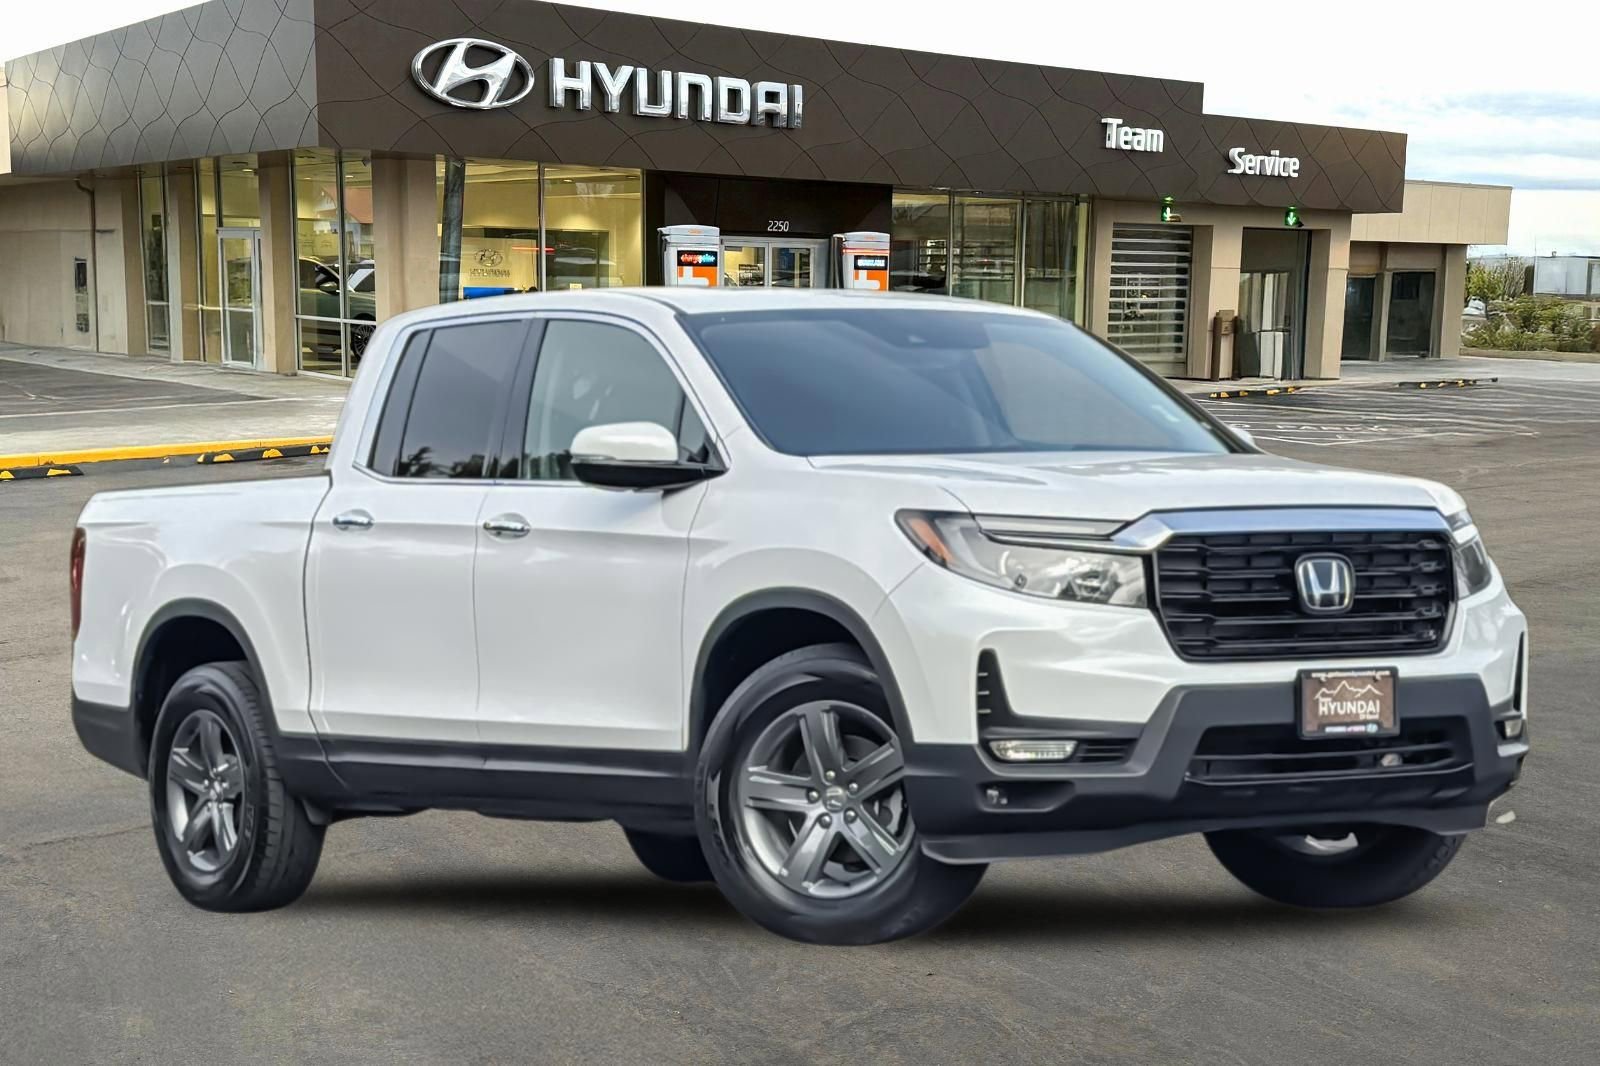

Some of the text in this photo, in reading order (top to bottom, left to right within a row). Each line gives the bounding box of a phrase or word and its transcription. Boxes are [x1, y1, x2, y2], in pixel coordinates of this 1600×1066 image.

[549, 57, 803, 129] HYUNDAI
[1101, 117, 1164, 152] Team
[1227, 147, 1300, 178] Service
[767, 220, 789, 232] 2250
[1318, 699, 1380, 716] HYUNDAI
